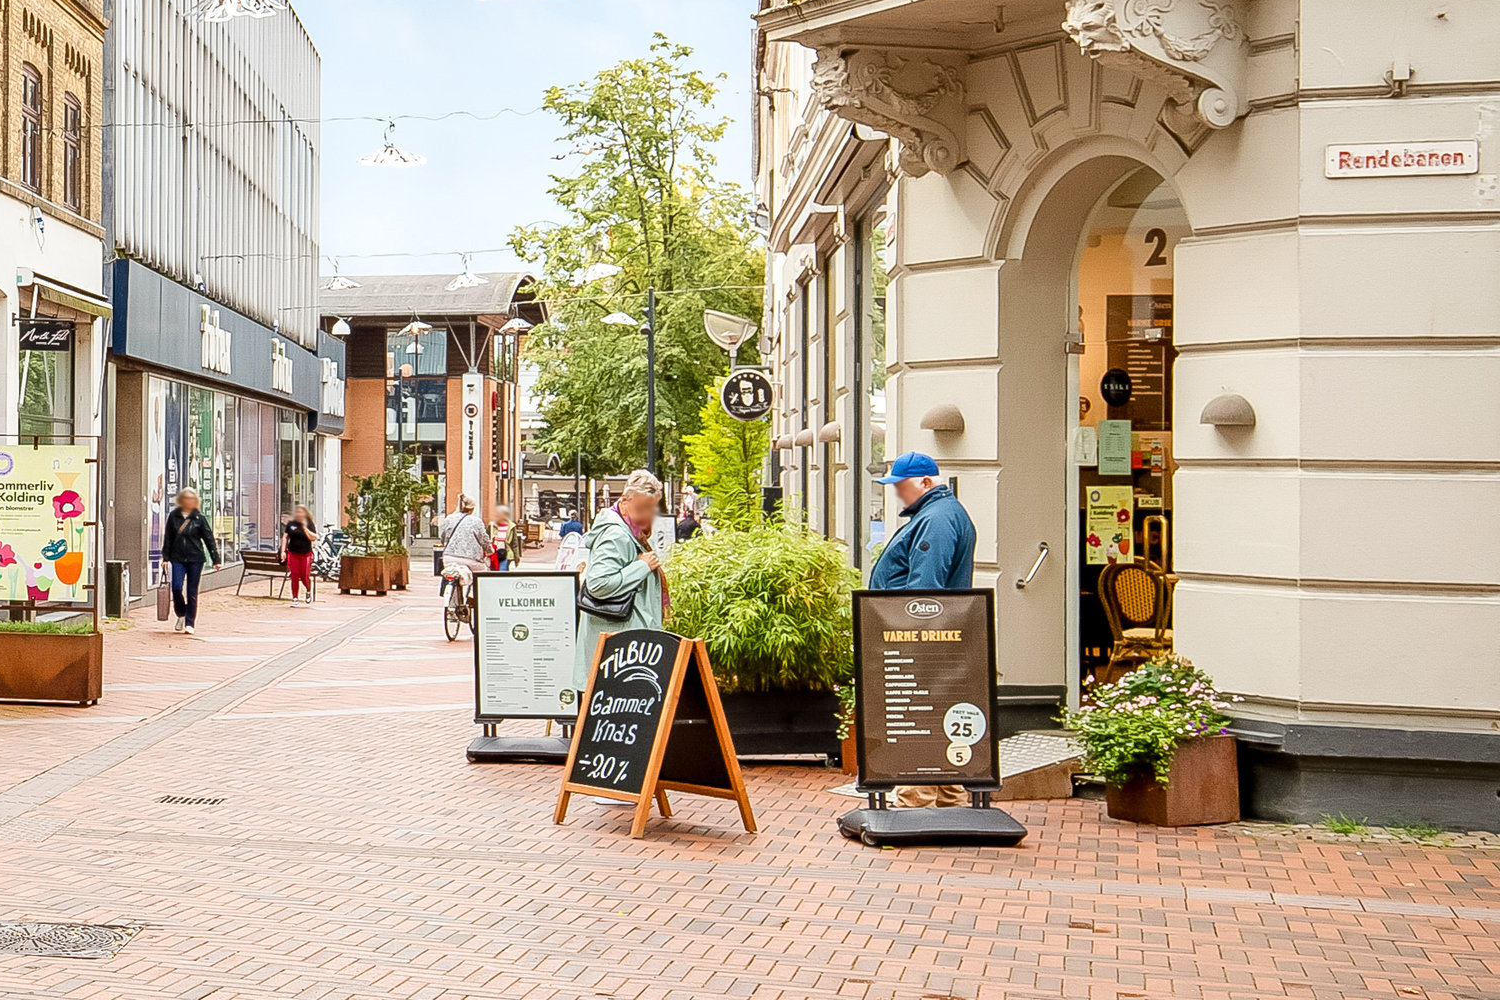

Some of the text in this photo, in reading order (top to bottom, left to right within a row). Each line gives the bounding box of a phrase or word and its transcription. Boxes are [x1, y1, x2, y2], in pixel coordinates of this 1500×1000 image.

[1338, 149, 1465, 170] Rendebanen
[1144, 227, 1167, 266] 2
[498, 598, 556, 608] VELKOMMEN
[883, 630, 962, 642] VARME DRIKKE
[590, 690, 655, 716] Gammel
[591, 719, 638, 745] Knas
